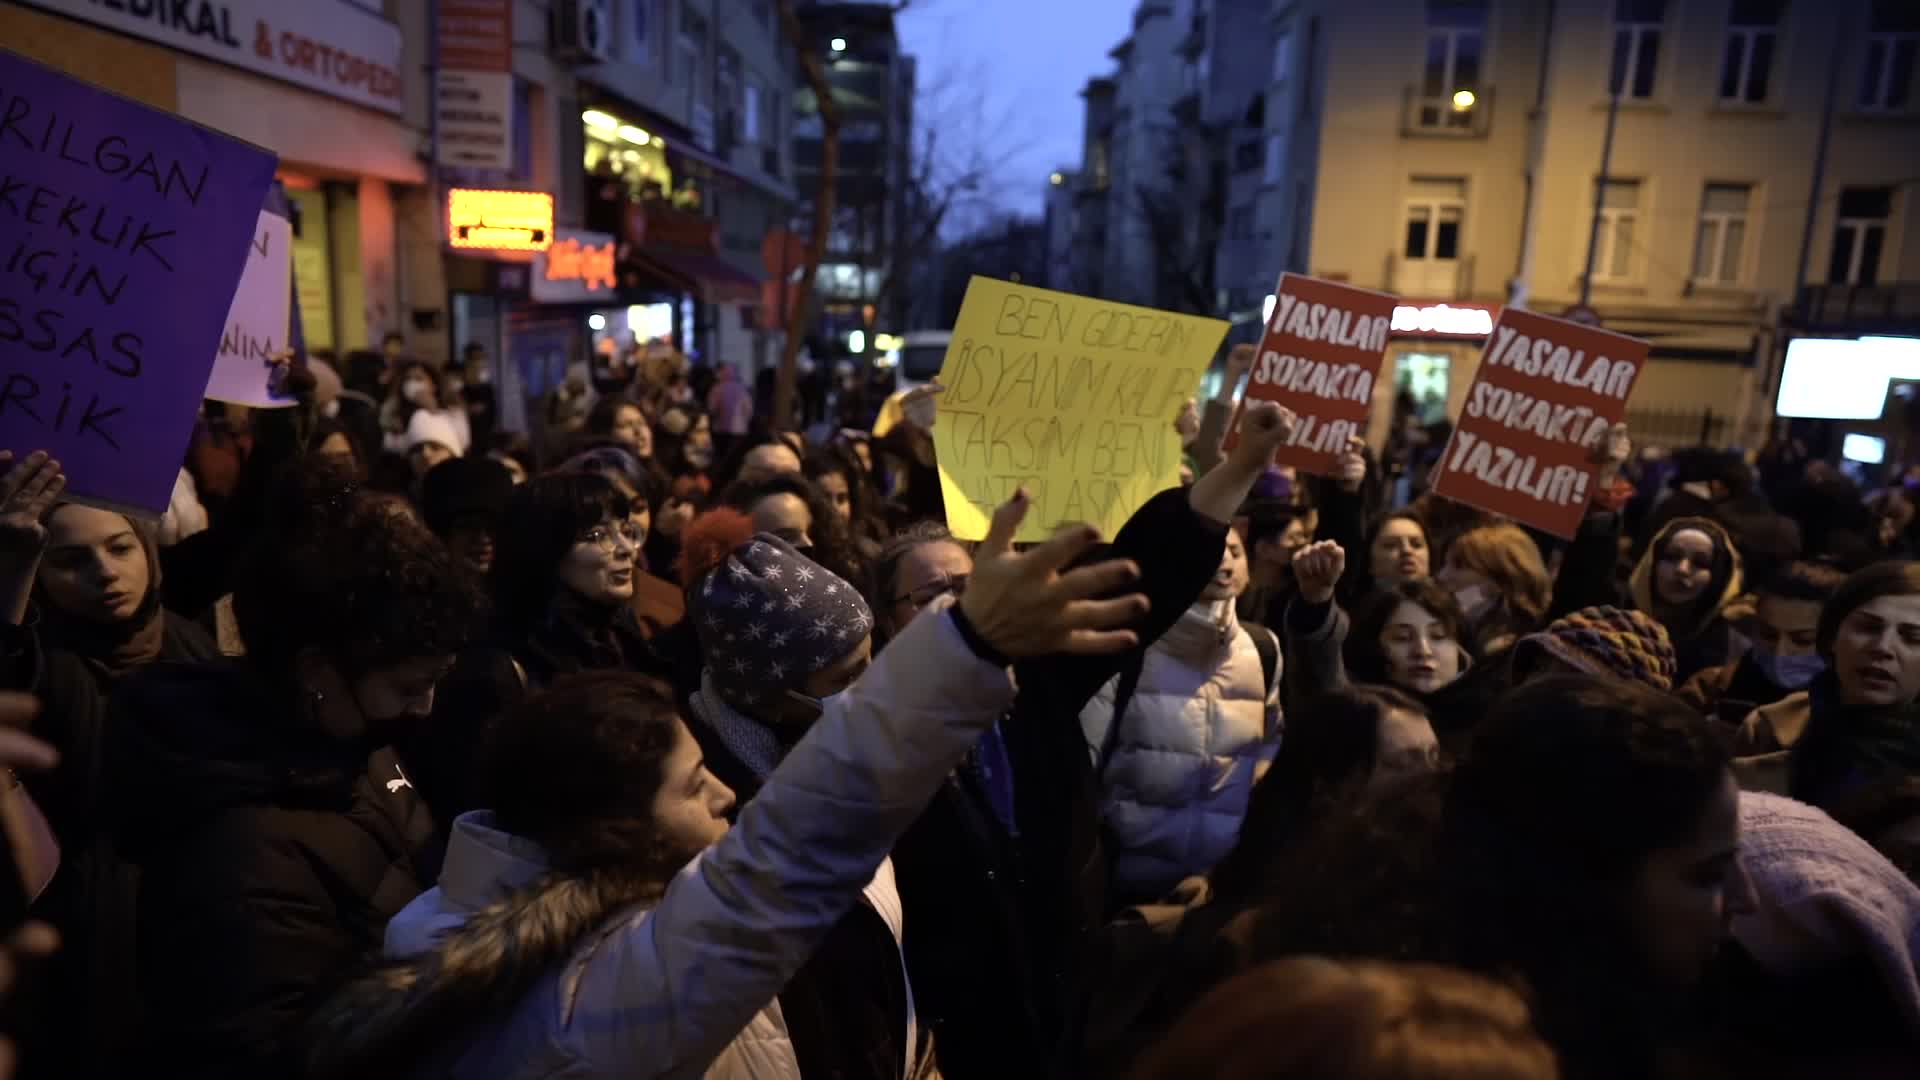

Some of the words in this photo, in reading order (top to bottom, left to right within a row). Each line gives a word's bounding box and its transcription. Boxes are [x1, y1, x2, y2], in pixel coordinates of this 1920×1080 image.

[0, 92, 209, 207] RILGAN
[0, 175, 177, 272] KEKLİK
[0, 299, 144, 378] SSAS
[994, 294, 1077, 344] BEN
[1271, 293, 1391, 352] YASALAR
[1254, 351, 1373, 405] SOKAKTA
[1487, 325, 1636, 400] YASALAR
[0, 373, 124, 451] RİK
[1466, 381, 1611, 449] SOKAKTA
[1447, 430, 1590, 506] YAZILIR!
